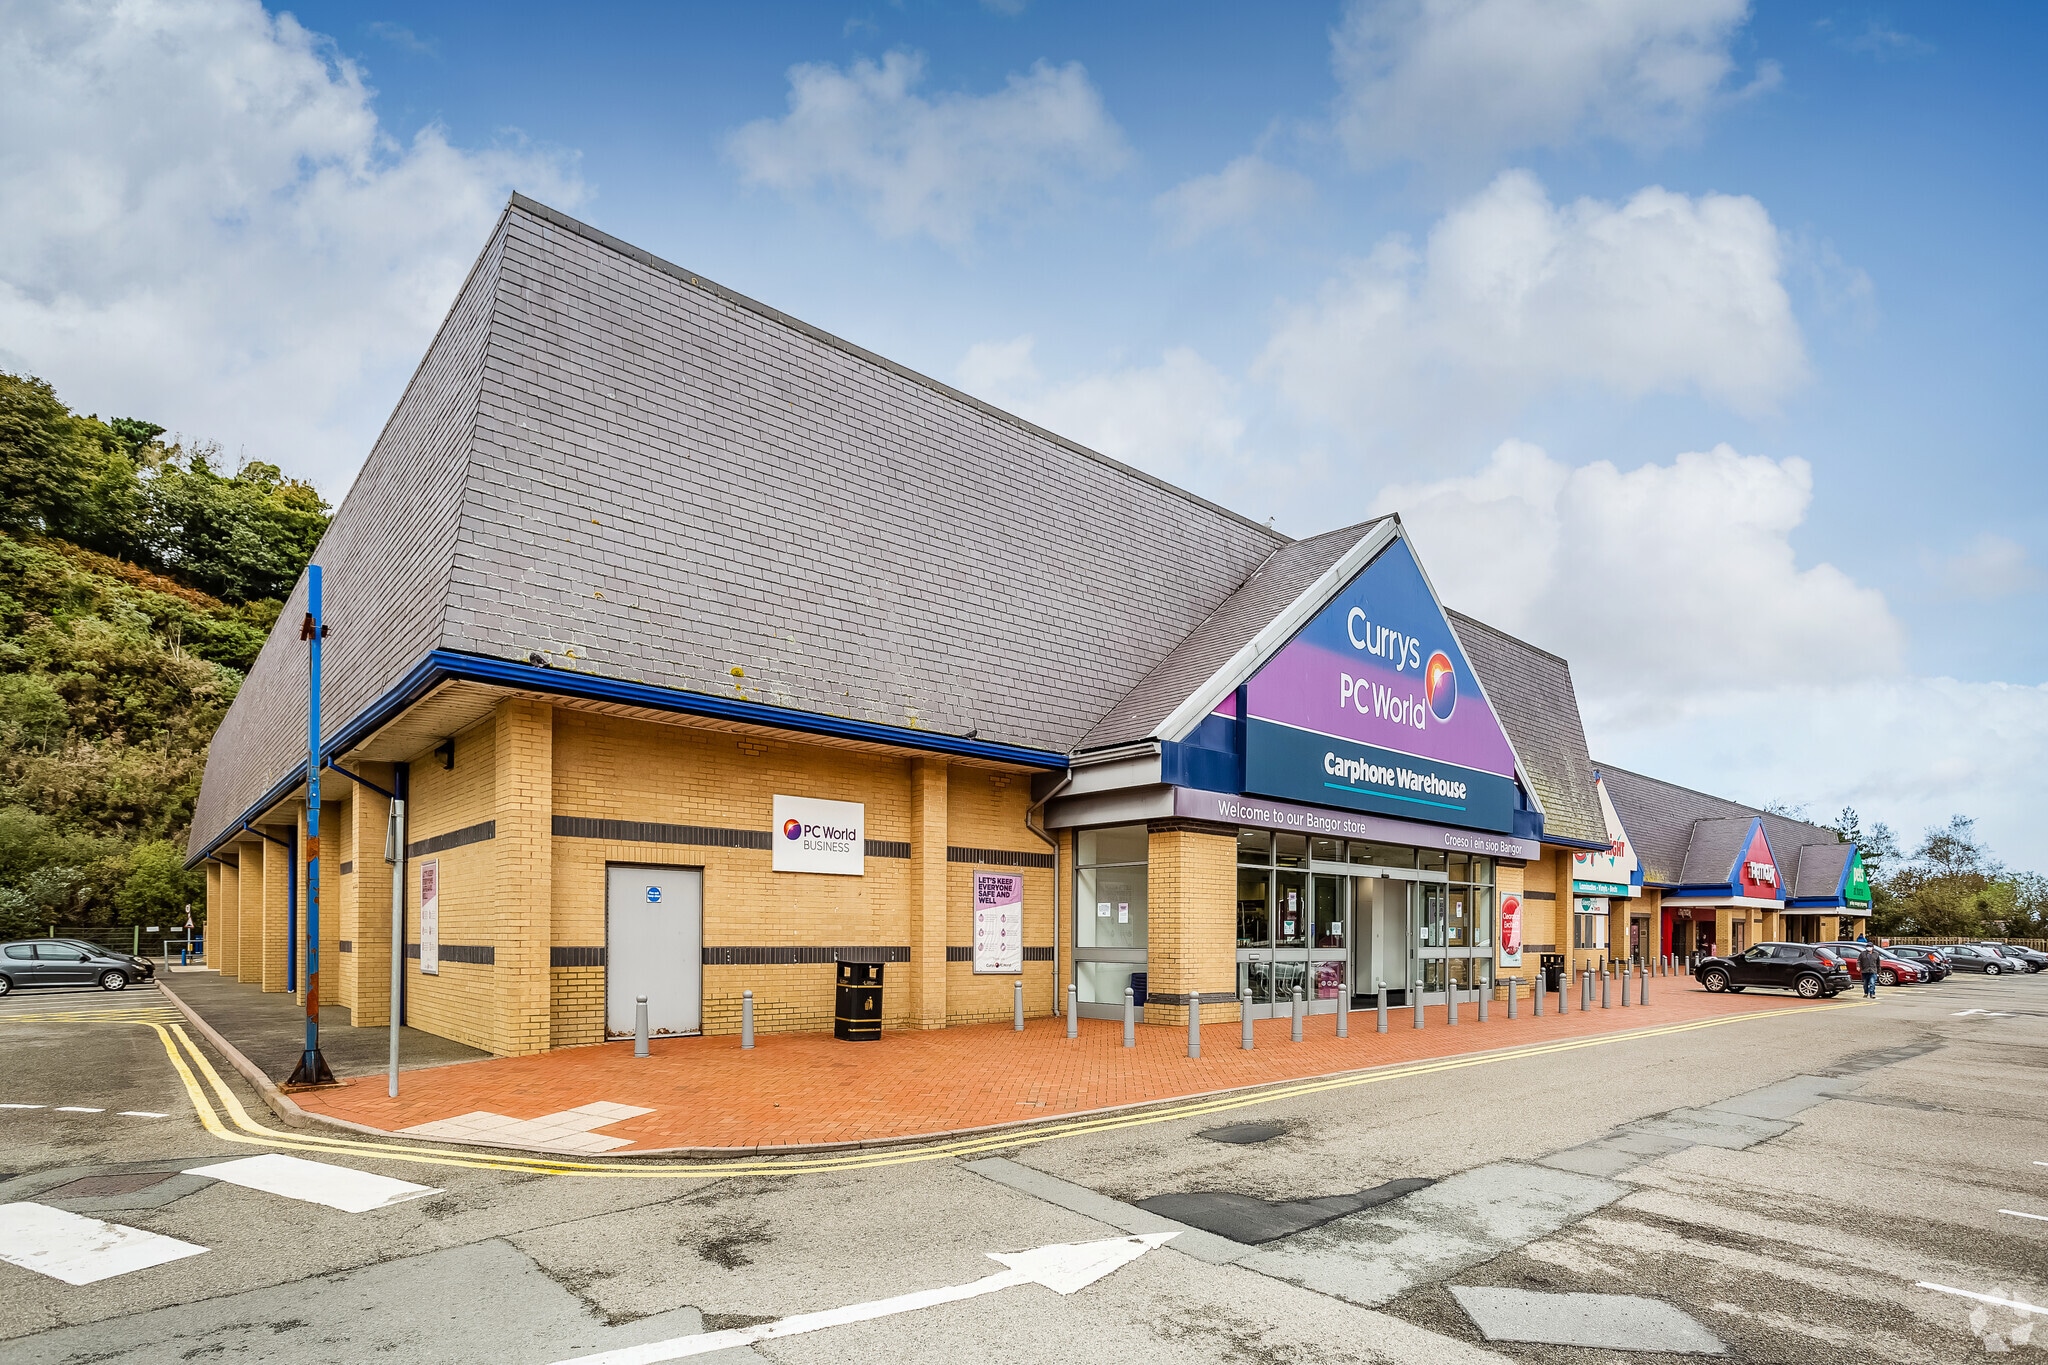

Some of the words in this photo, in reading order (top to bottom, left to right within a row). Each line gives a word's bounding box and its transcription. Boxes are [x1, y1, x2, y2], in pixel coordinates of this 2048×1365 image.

[1347, 606, 1421, 672] Currys
[1340, 672, 1370, 715] PC
[1372, 682, 1426, 730] World
[1324, 752, 1395, 784] Carphone
[1396, 767, 1467, 800] Warehouse
[1217, 799, 1270, 821] Welcome
[1272, 808, 1284, 823] to
[1286, 812, 1304, 826] our
[1306, 812, 1341, 832] Bangor
[1343, 819, 1366, 834] store
[804, 824, 821, 838] PC
[822, 826, 856, 841] World
[803, 840, 850, 853] BUSINESS
[1444, 832, 1469, 848] Croeso
[1470, 836, 1473, 848] i
[1474, 837, 1485, 849] ein
[1485, 839, 1499, 853] siop
[1500, 840, 1523, 856] Bangor
[978, 876, 996, 884] LET'S
[997, 877, 1013, 885] KEEP
[978, 883, 1013, 892] EVERYONE
[978, 890, 995, 898] SAFE
